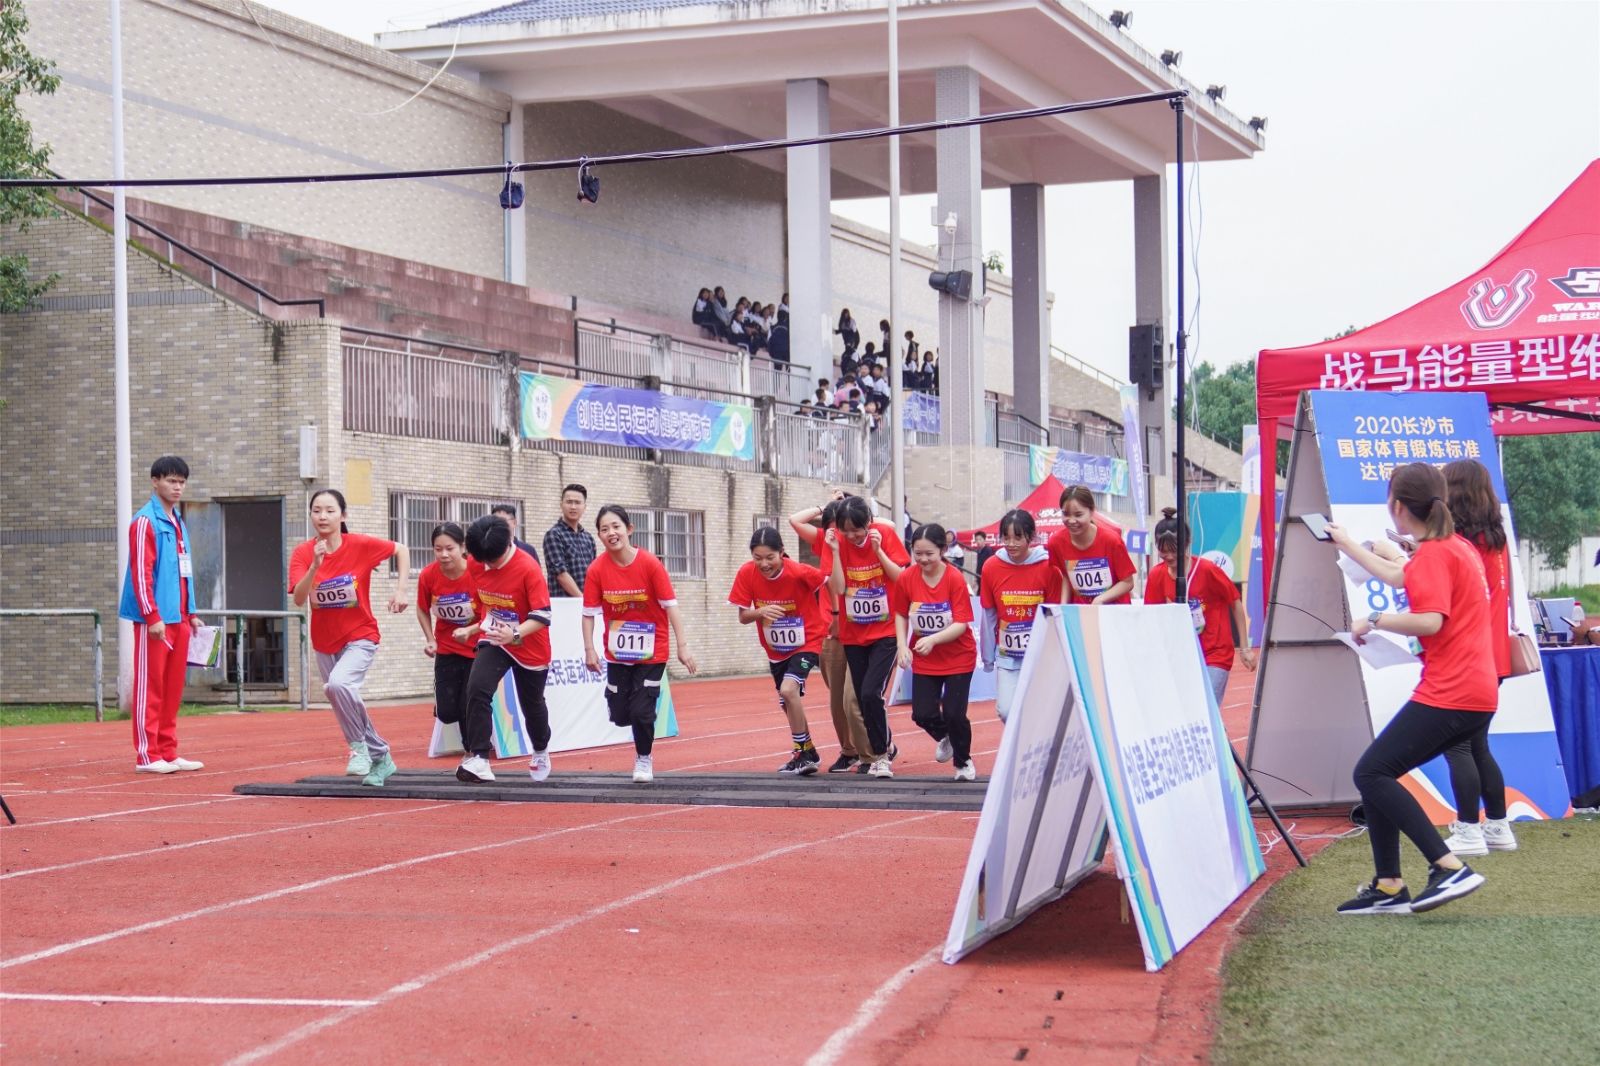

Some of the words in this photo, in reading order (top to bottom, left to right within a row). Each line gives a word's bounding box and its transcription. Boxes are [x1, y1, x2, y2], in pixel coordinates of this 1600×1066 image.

[1354, 416, 1454, 436] 2020长沙市
[1337, 438, 1481, 459] 国家体育锻炼标准
[1076, 571, 1103, 587] 004
[317, 589, 347, 603] 005
[438, 605, 466, 618] 002
[853, 600, 881, 614] 006
[917, 615, 945, 629] 003
[617, 634, 645, 650] 011
[770, 629, 796, 644] 010
